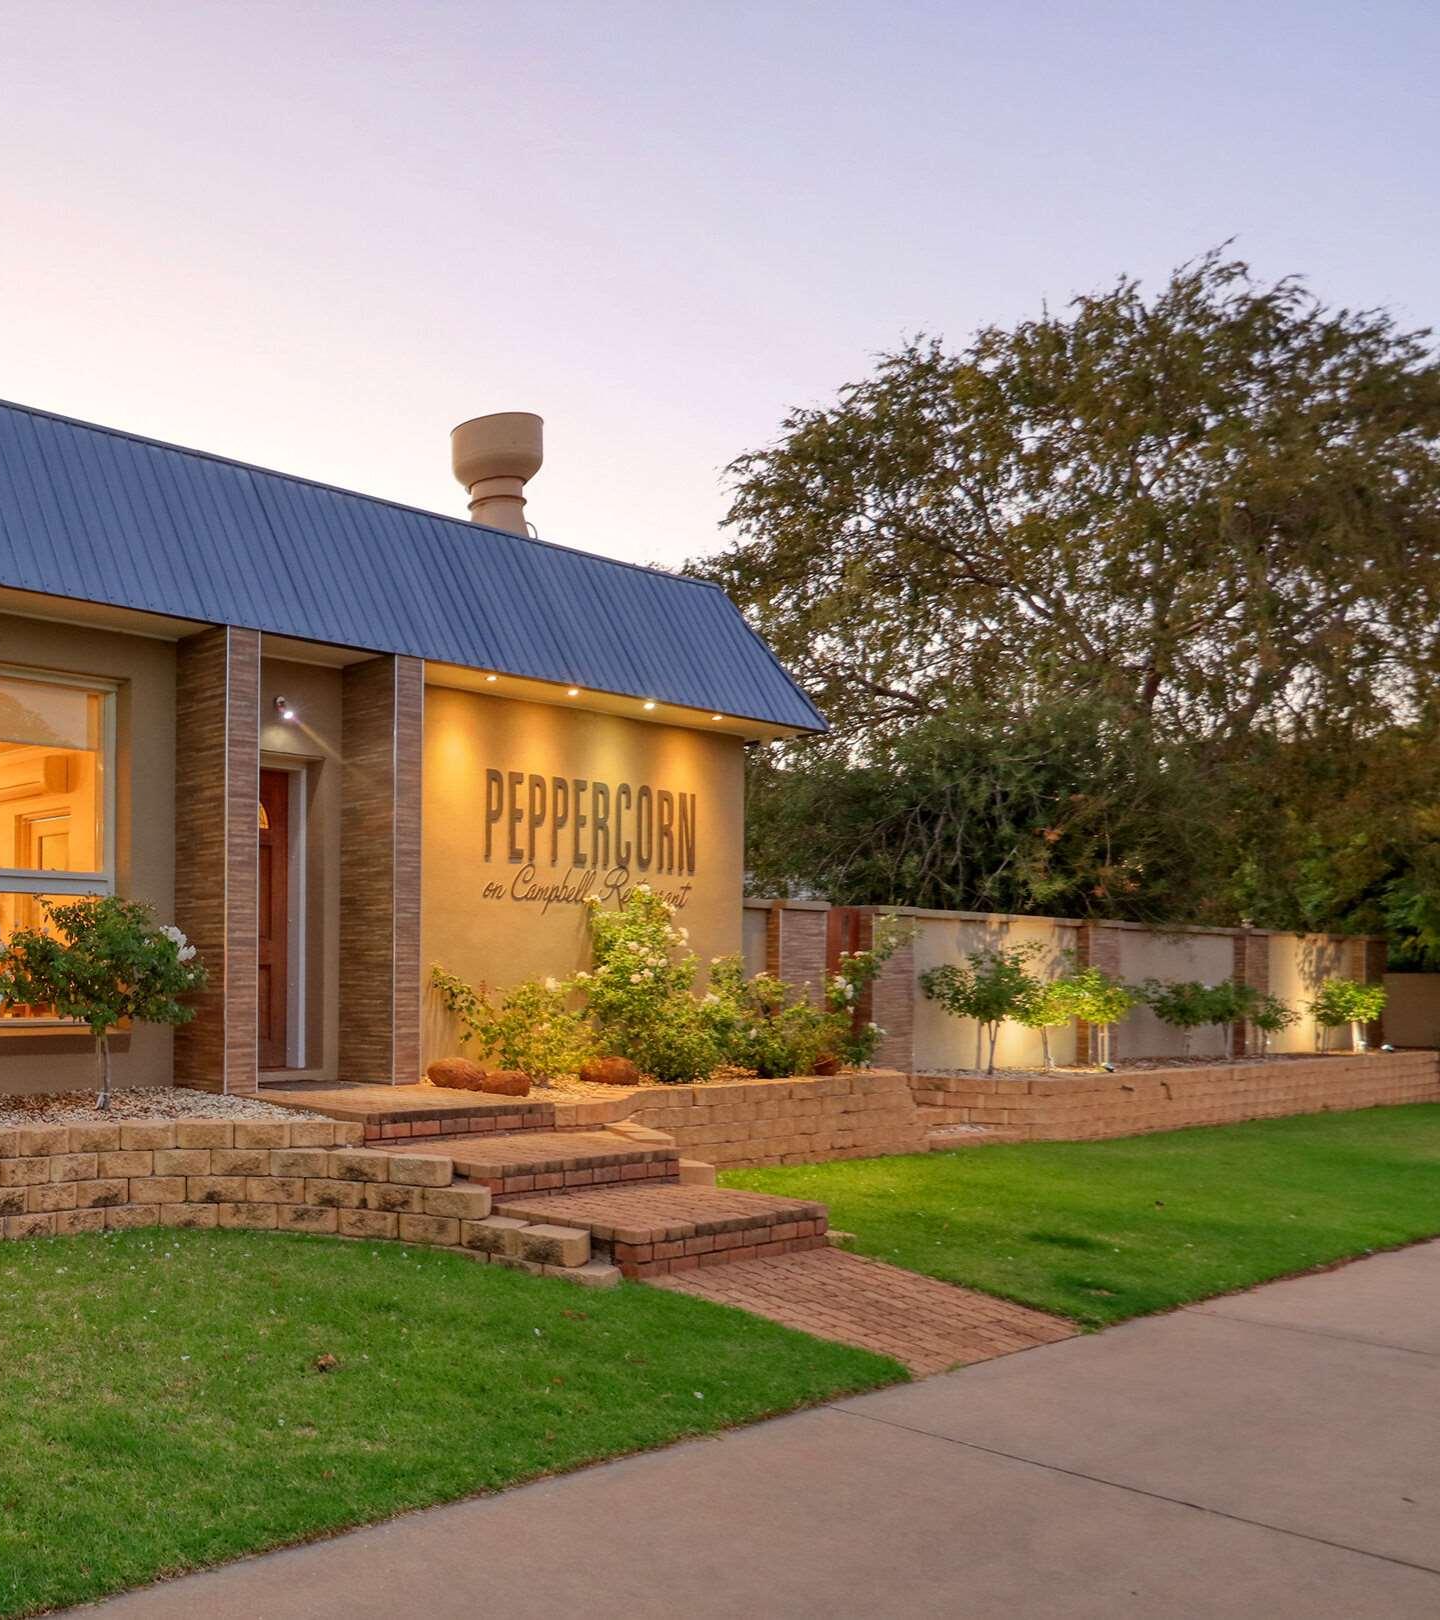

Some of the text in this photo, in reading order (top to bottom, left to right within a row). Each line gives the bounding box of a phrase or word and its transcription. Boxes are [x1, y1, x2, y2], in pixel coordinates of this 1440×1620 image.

[485, 768, 696, 876] PEPPERCORN
[482, 864, 692, 915] on Campbell Rerant
